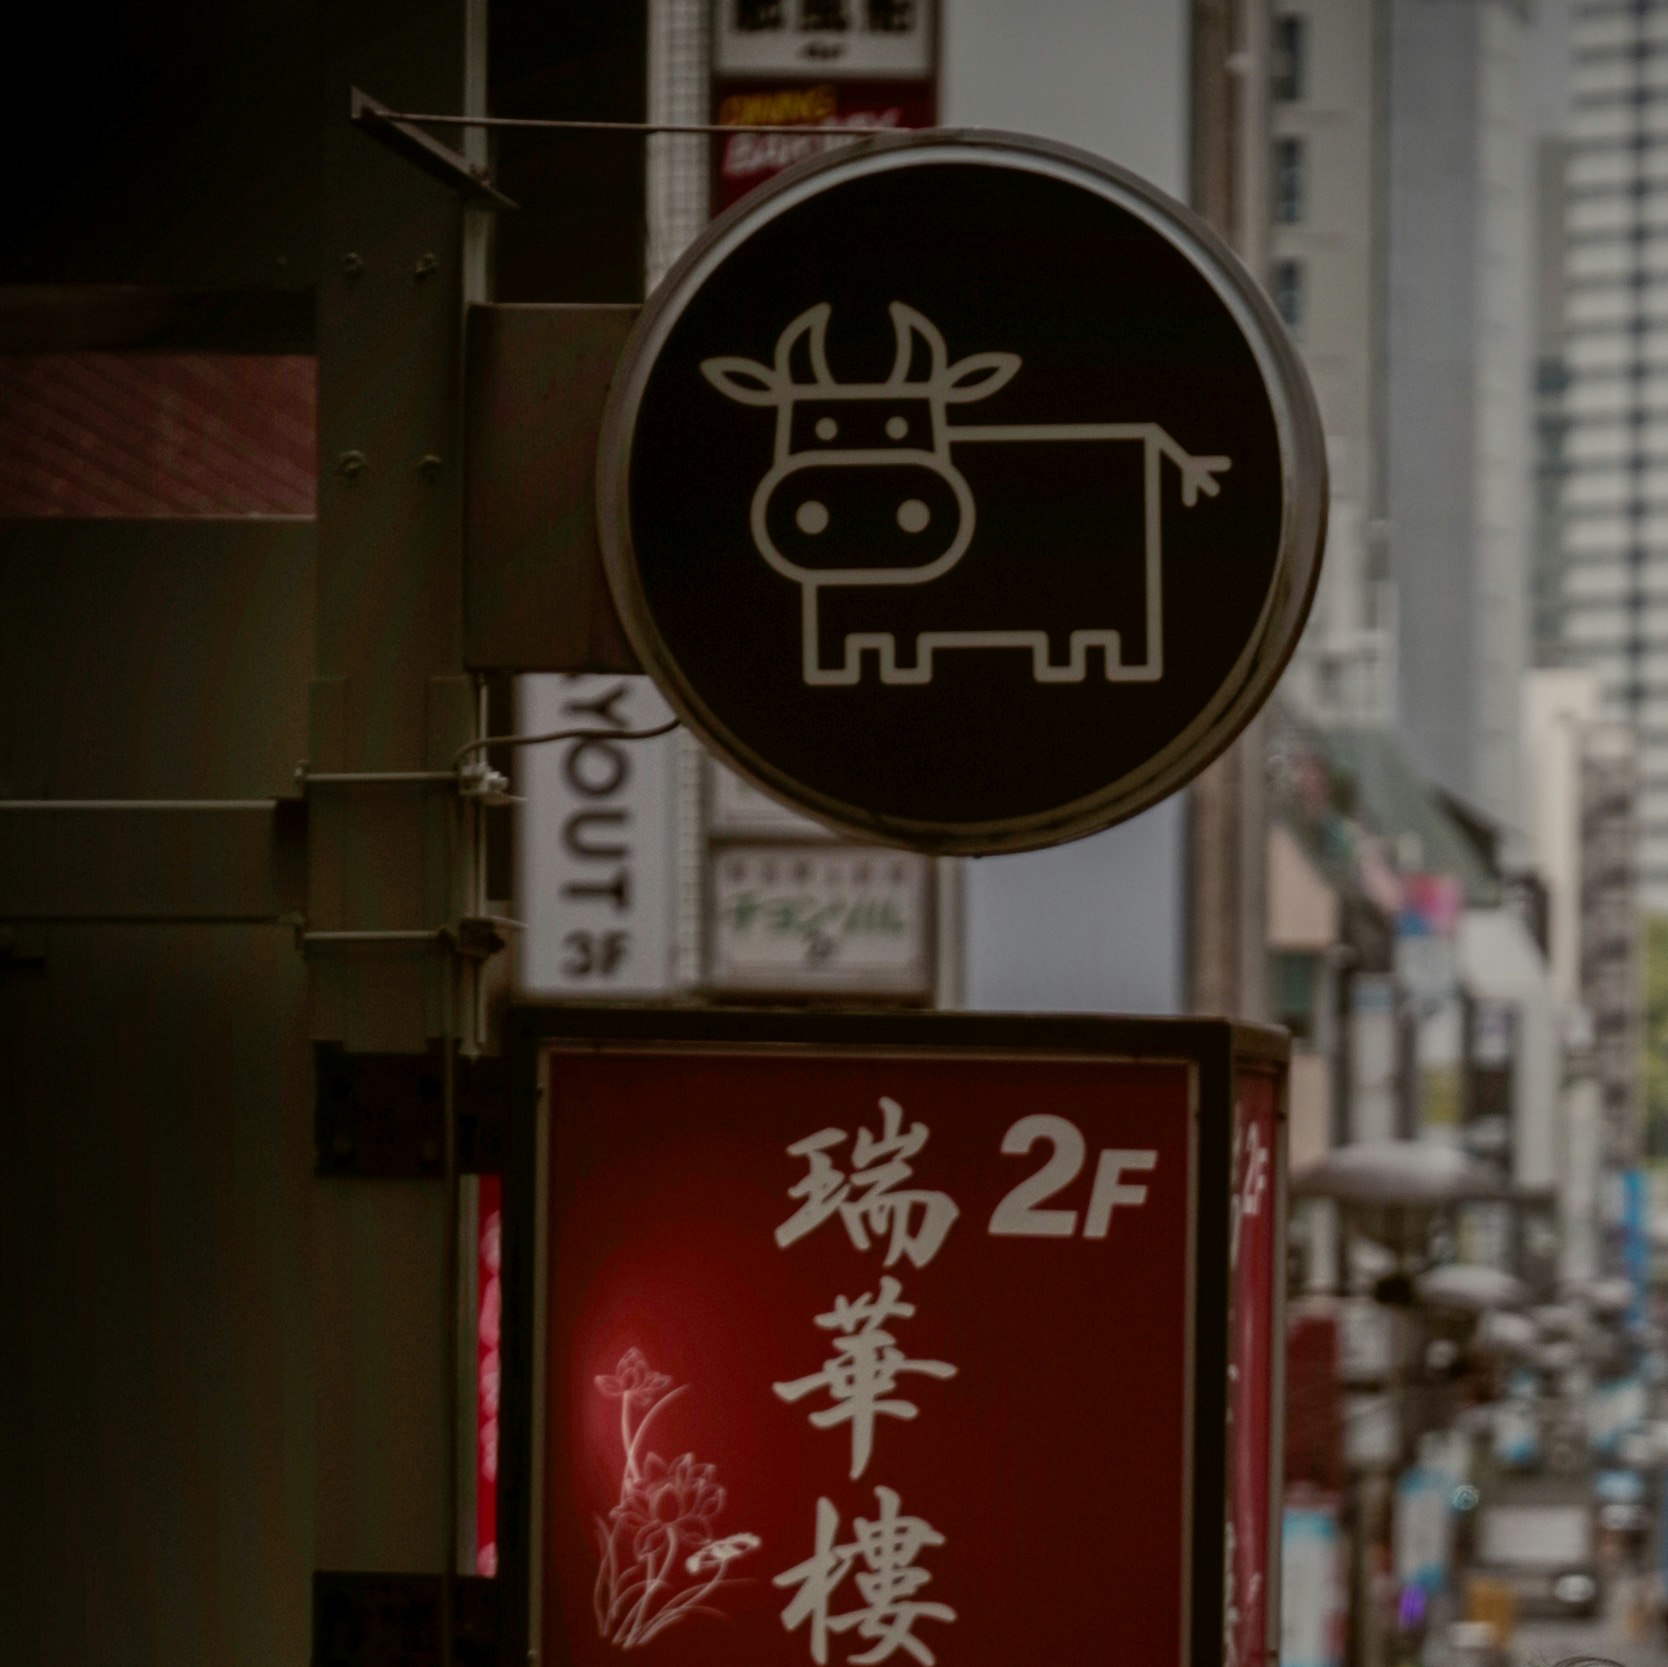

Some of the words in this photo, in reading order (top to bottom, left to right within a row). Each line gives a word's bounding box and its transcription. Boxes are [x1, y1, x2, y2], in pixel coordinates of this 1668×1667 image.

[561, 672, 632, 914] YOUT
[987, 1113, 1159, 1240] 2F
[772, 1095, 959, 1667] 瑞華樓
